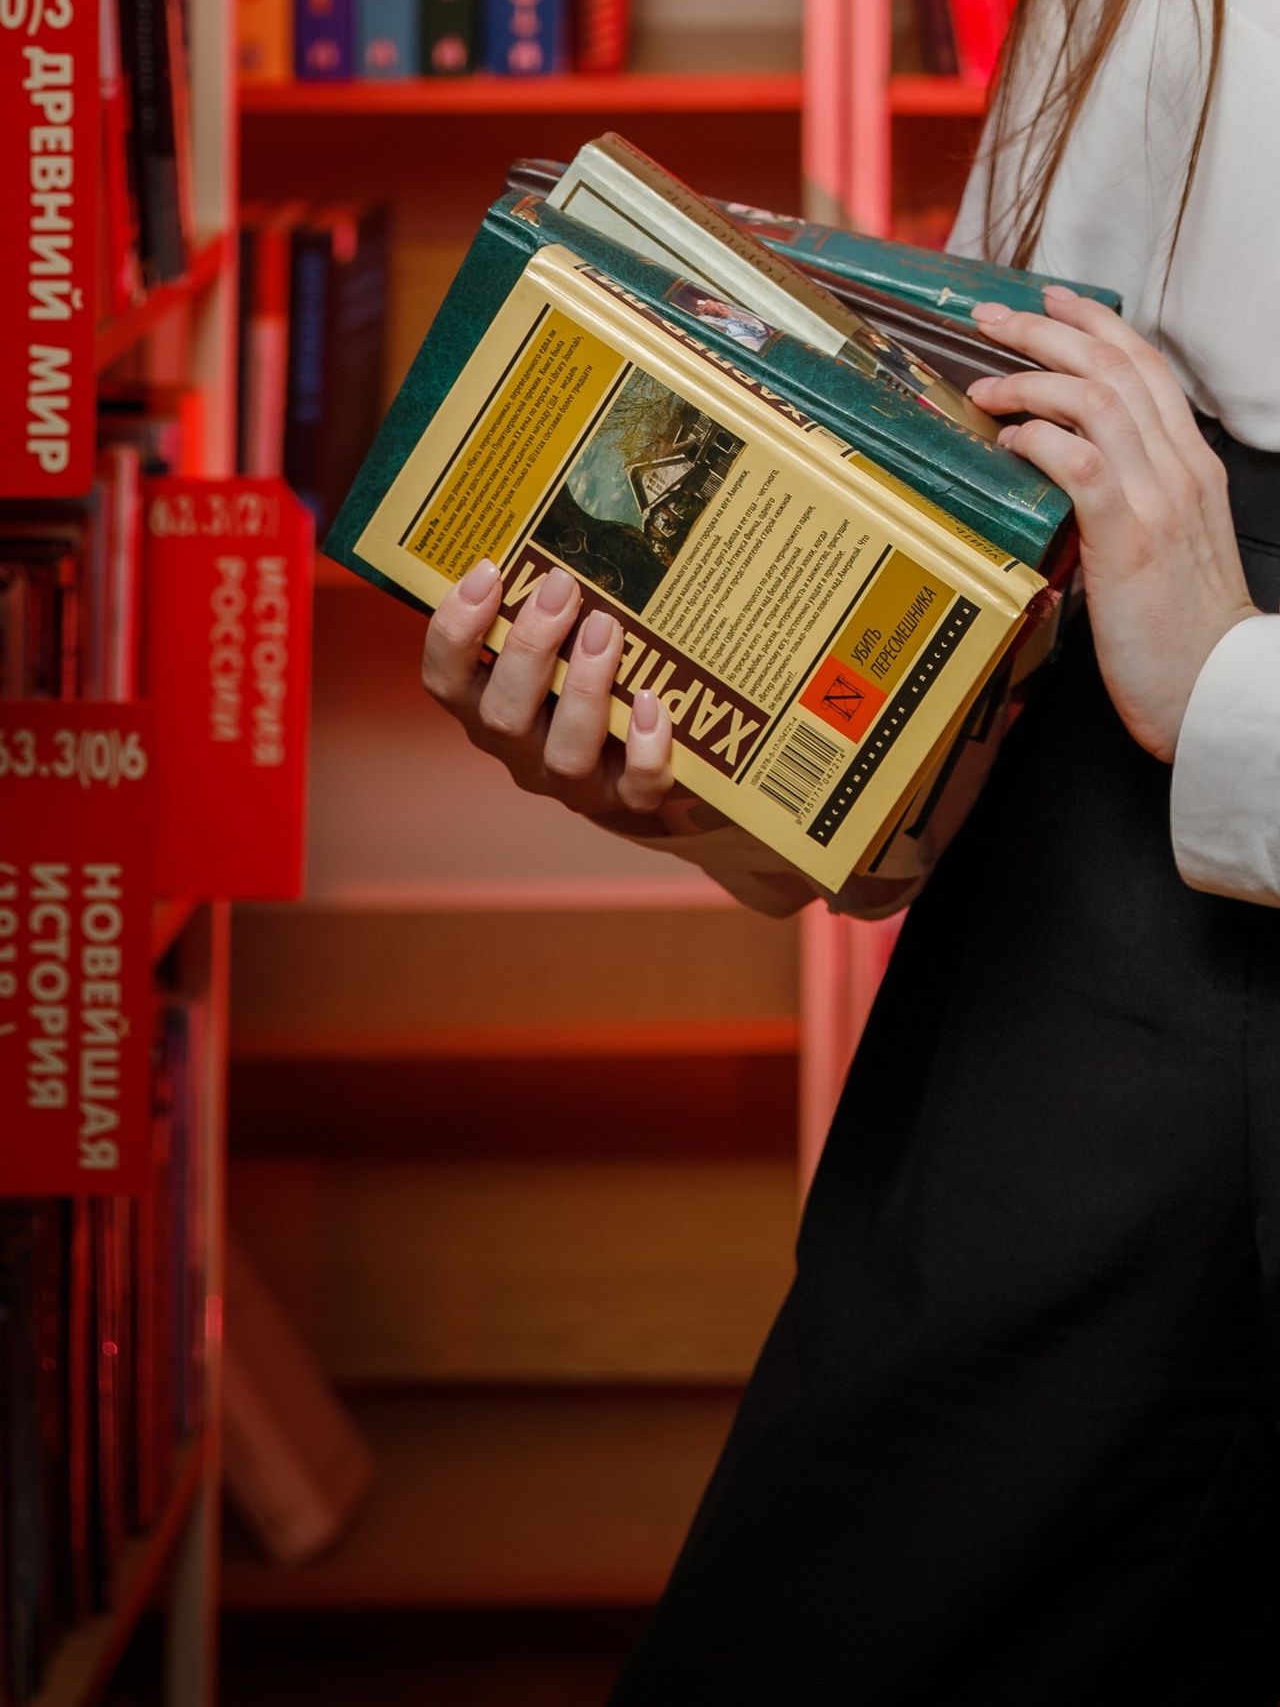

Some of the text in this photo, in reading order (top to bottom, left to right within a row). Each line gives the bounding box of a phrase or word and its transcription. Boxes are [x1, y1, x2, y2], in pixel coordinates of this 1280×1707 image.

[23, 47, 82, 473] ДРЕВНИЙ МИР
[412, 328, 557, 553] Харпер Ли автор романа «Убить пересмешника», переведенного едва ли
[425, 339, 565, 560] не на все языки мира удостоенного Пулитцеровской премии. Книга была
[435, 335, 584, 567] признана лучшим американским романом века по версии «Library Journal»,
[448, 549, 463, 569] затем
[459, 520, 481, 551] принесла
[477, 499, 494, 522] автору
[490, 474, 510, 501] высшую
[505, 433, 535, 476] гражданскую
[531, 408, 551, 435] награду
[545, 393, 559, 410] США
[559, 365, 578, 390] медаль
[471, 543, 482, 553] Ее
[478, 507, 503, 544] суммарный
[499, 488, 516, 508] тираж
[511, 466, 529, 489] только
[527, 439, 546, 463] Штатах
[542, 411, 563, 441] составил
[558, 393, 575, 413] более
[570, 364, 593, 394] тридцати
[486, 509, 516, 554] экземпляров!
[645, 469, 750, 625] История маленького сонного городка на юге Америки,
[657, 533, 723, 632] поведанная маленькой девочкой.
[666, 469, 780, 639] История ее брата Джима, друга Дилла ее отца честного,
[677, 496, 775, 646] принципиального адвоката Аттикуса Финча, одного
[687, 492, 793, 654] из последних лучших представителей старой «южной
[706, 504, 816, 668] История судебного процесса по делу чернокожего парня,
[725, 529, 828, 682] Но прежде всего история переломной эпохи, когда
[737, 518, 850, 689] ксенофобия, расизм, нетерпимость ханжество, присущие
[252, 557, 289, 767] ИСТОРИЯ
[697, 616, 730, 660] аристократии».
[717, 546, 804, 675] обвиненного насилии над белой девушкой.
[747, 549, 846, 696] американскому югу, постепенно уходят прошлое.
[757, 533, 870, 703] «Ветер перемен» только-только повеял над Америкой. Что
[848, 624, 883, 666] УБИТЬ
[868, 585, 938, 679] ПЕРЕСМЕШНИКА
[909, 606, 971, 693] классика
[596, 626, 761, 766] ХАРПЕ
[749, 715, 798, 786] ISBN 978-5-17-104721-4
[767, 670, 798, 711] он принесет?..
[798, 750, 846, 818] 785171 047214
[27, 863, 71, 1108] ИСТОРИЯ
[78, 863, 130, 1170] НОВЕЙШАЯ
